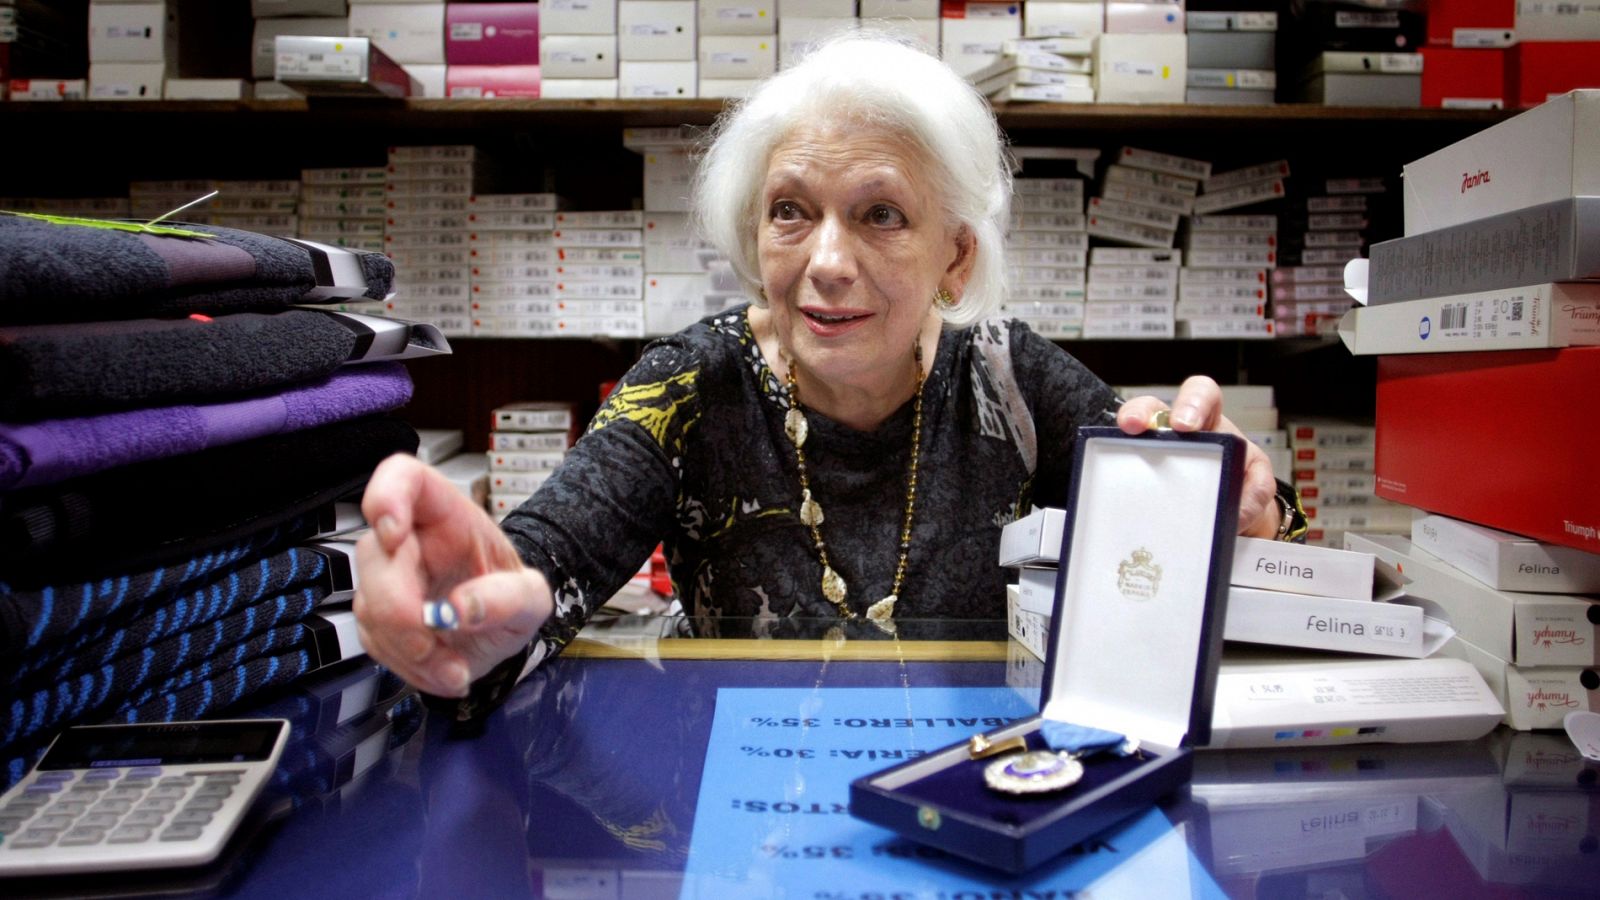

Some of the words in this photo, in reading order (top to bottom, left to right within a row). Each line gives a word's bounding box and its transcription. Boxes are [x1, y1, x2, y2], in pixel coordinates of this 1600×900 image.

[1461, 169, 1492, 193] Janira
[1563, 519, 1593, 541] Triumph
[751, 717, 821, 728] 35%
[738, 747, 815, 759] 30%
